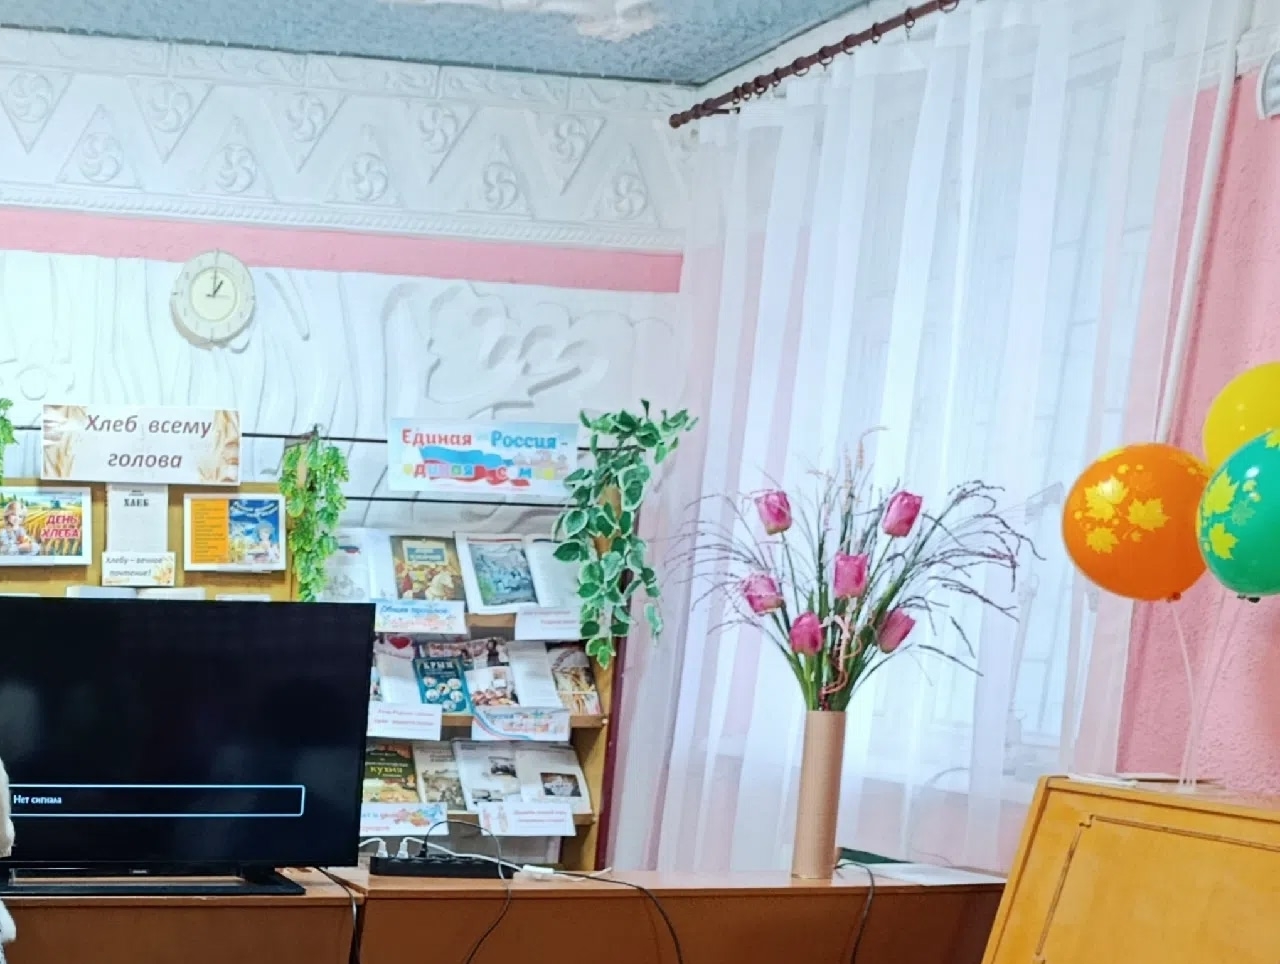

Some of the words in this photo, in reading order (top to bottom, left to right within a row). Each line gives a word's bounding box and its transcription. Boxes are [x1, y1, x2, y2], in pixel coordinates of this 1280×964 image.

[84, 413, 139, 433] Хлеб
[147, 419, 213, 438] всему
[401, 427, 473, 447] Единая
[490, 429, 557, 449] Россия
[107, 453, 183, 469] голова
[41, 528, 79, 538] ХЛЕБА
[13, 794, 30, 804] Нет
[30, 796, 62, 804] сигнала
